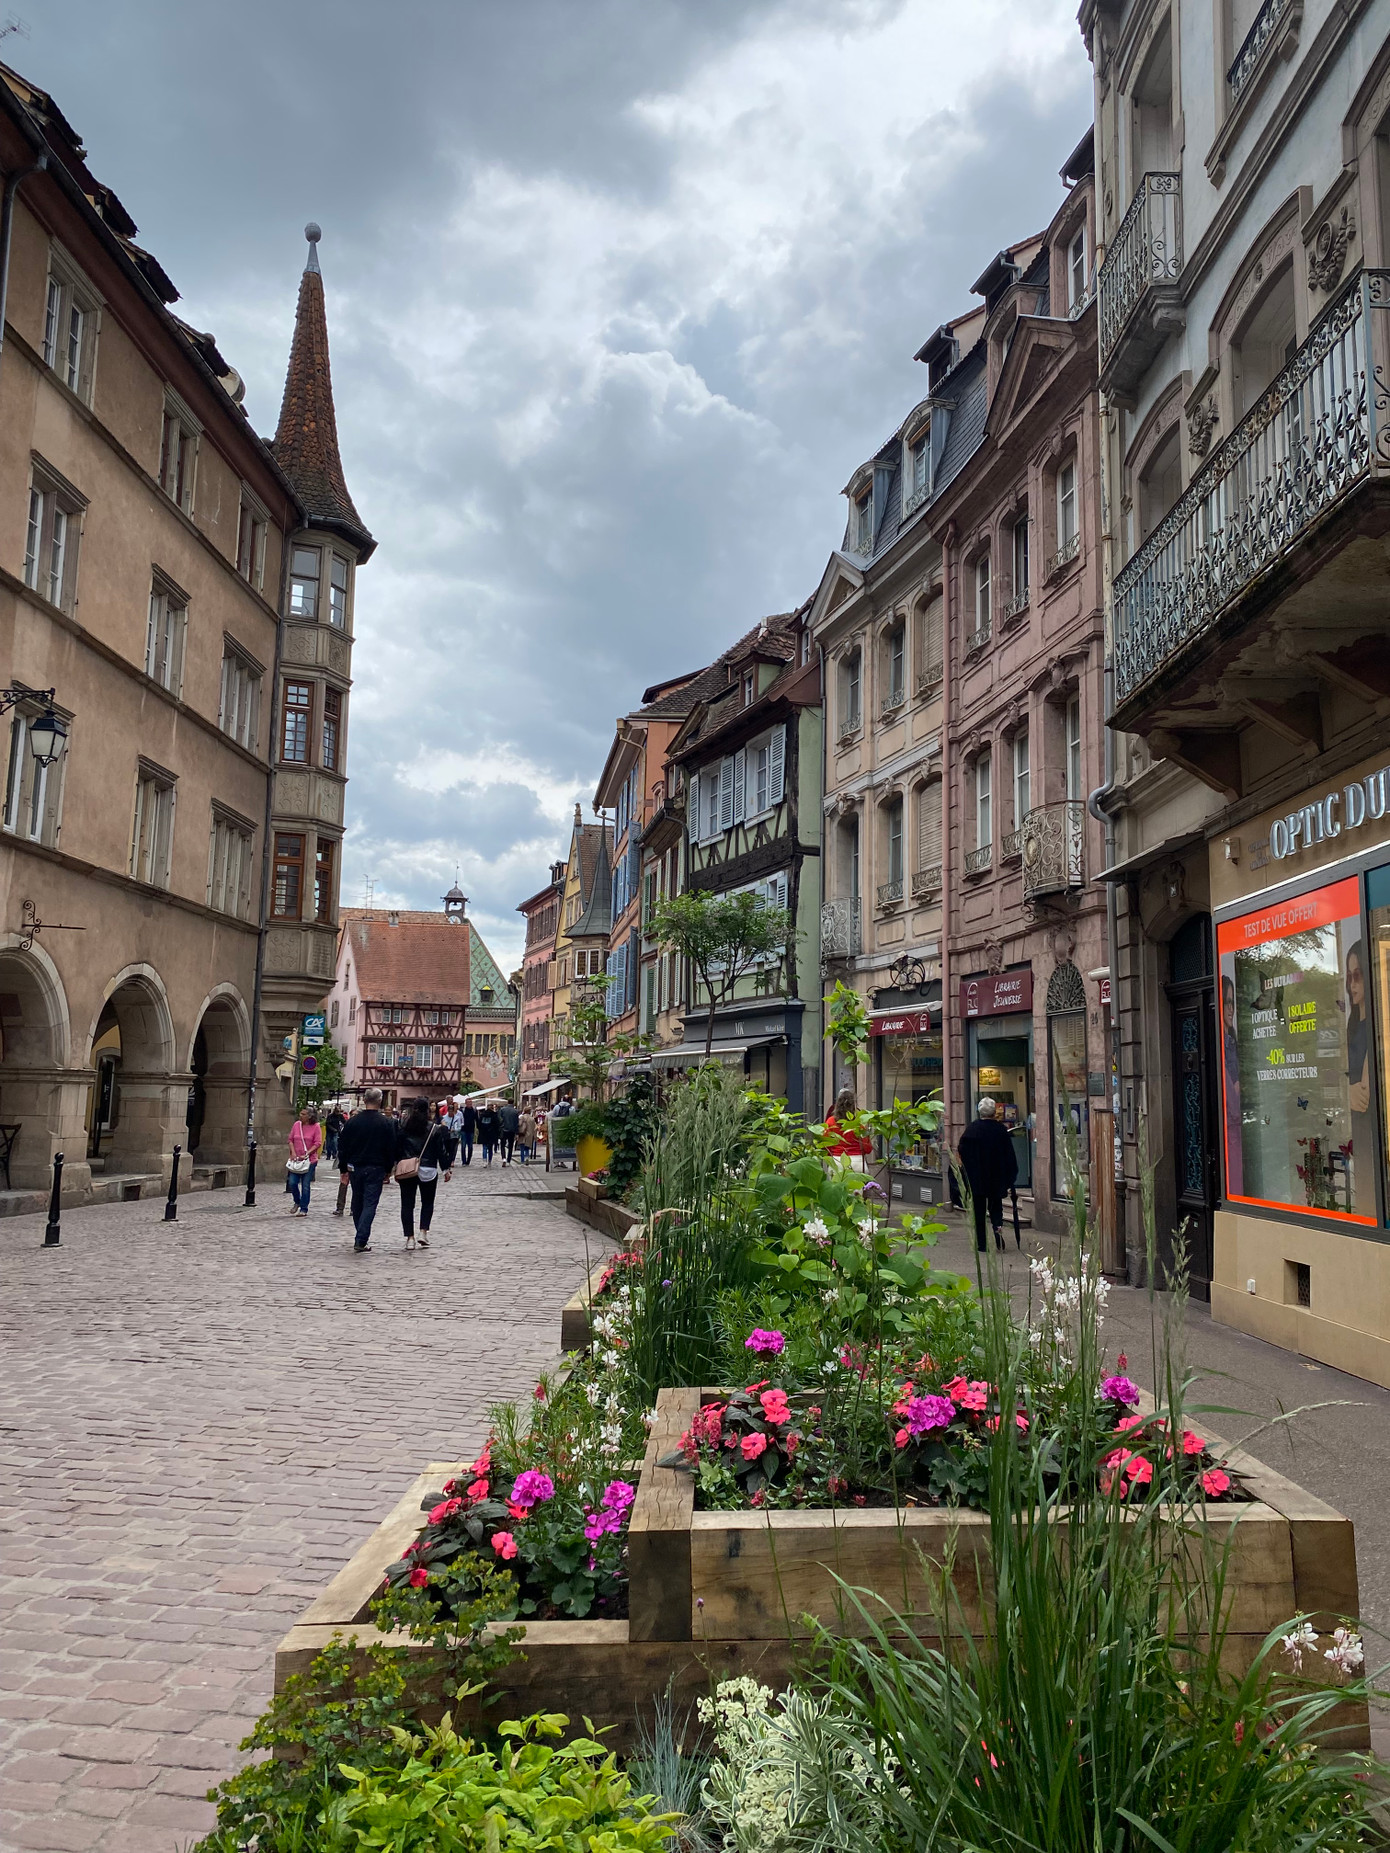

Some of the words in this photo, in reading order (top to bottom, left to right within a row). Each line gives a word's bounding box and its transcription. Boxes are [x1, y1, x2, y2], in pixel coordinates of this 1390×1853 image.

[1270, 792, 1340, 860] OPTIC
[1244, 921, 1260, 938] TEST
[1261, 917, 1271, 933] DE
[1271, 912, 1287, 930] VUE
[1288, 901, 1318, 925] OFFERT
[994, 979, 1022, 994] LIBRAIRIE
[1264, 978, 1273, 990] LES
[993, 994, 1023, 1008] JEUNESSE
[1291, 1001, 1317, 1016] SOLAIRE
[1254, 1008, 1278, 1023] OPTIQUE
[1289, 1018, 1317, 1034] OFFERTE
[1266, 1048, 1285, 1065] -40%
[1285, 1053, 1295, 1063] SUR
[1296, 1053, 1305, 1063] LES
[1256, 1070, 1277, 1081] VERRES
[1277, 1066, 1318, 1080] CORRECTEURS
